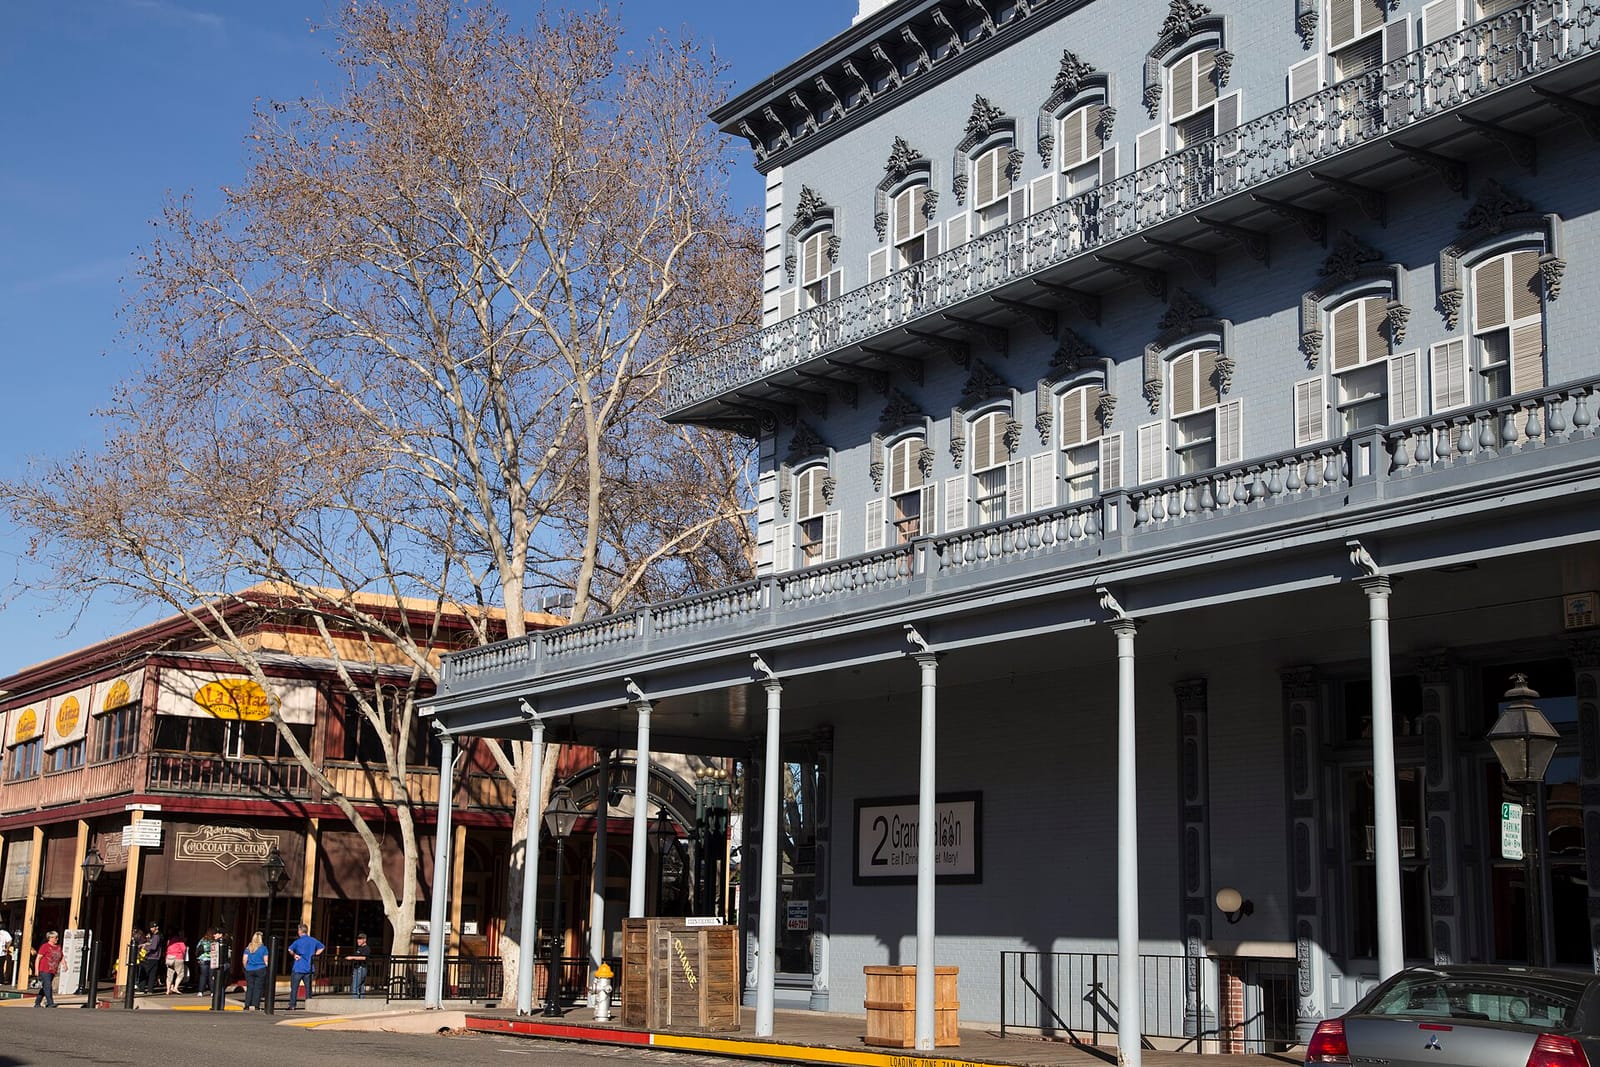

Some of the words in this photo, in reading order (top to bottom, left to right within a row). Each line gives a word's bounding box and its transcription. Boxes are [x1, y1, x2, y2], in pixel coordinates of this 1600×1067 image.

[207, 687, 224, 704] La
[1503, 804, 1509, 818] 2
[1510, 810, 1520, 819] HOUR
[1503, 820, 1520, 833] PARKING
[183, 839, 232, 855] CHOCOLATE
[234, 840, 273, 858] FACTORY
[871, 815, 889, 866] 2
[889, 1057, 917, 1067] LOADING
[920, 1059, 937, 1067] ZONE
